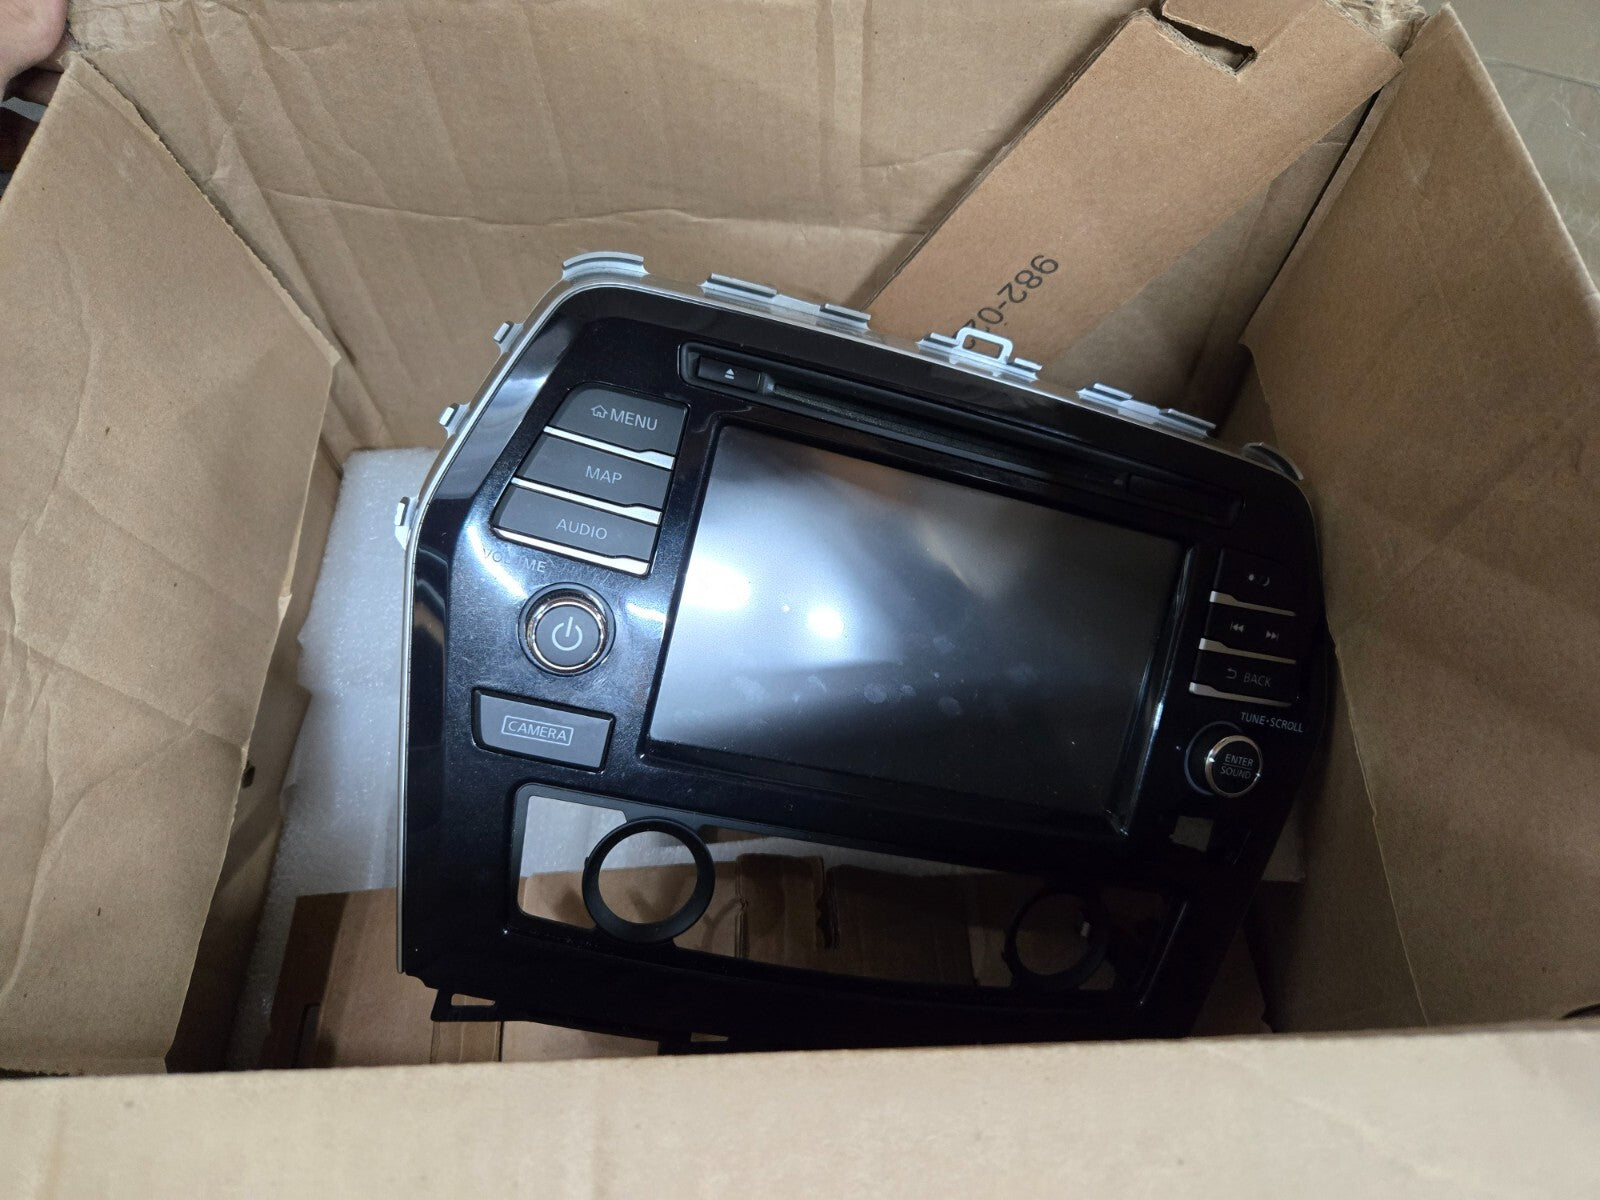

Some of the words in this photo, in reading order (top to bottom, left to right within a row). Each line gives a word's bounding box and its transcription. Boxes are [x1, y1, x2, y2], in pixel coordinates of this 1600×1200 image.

[610, 408, 658, 431] MENU
[585, 465, 623, 484] MAP
[555, 518, 608, 540] AUDIO
[1243, 673, 1272, 688] BACK
[507, 721, 568, 742] CAMERA
[1225, 753, 1254, 768] ENTER
[1220, 765, 1251, 780] SOUND
